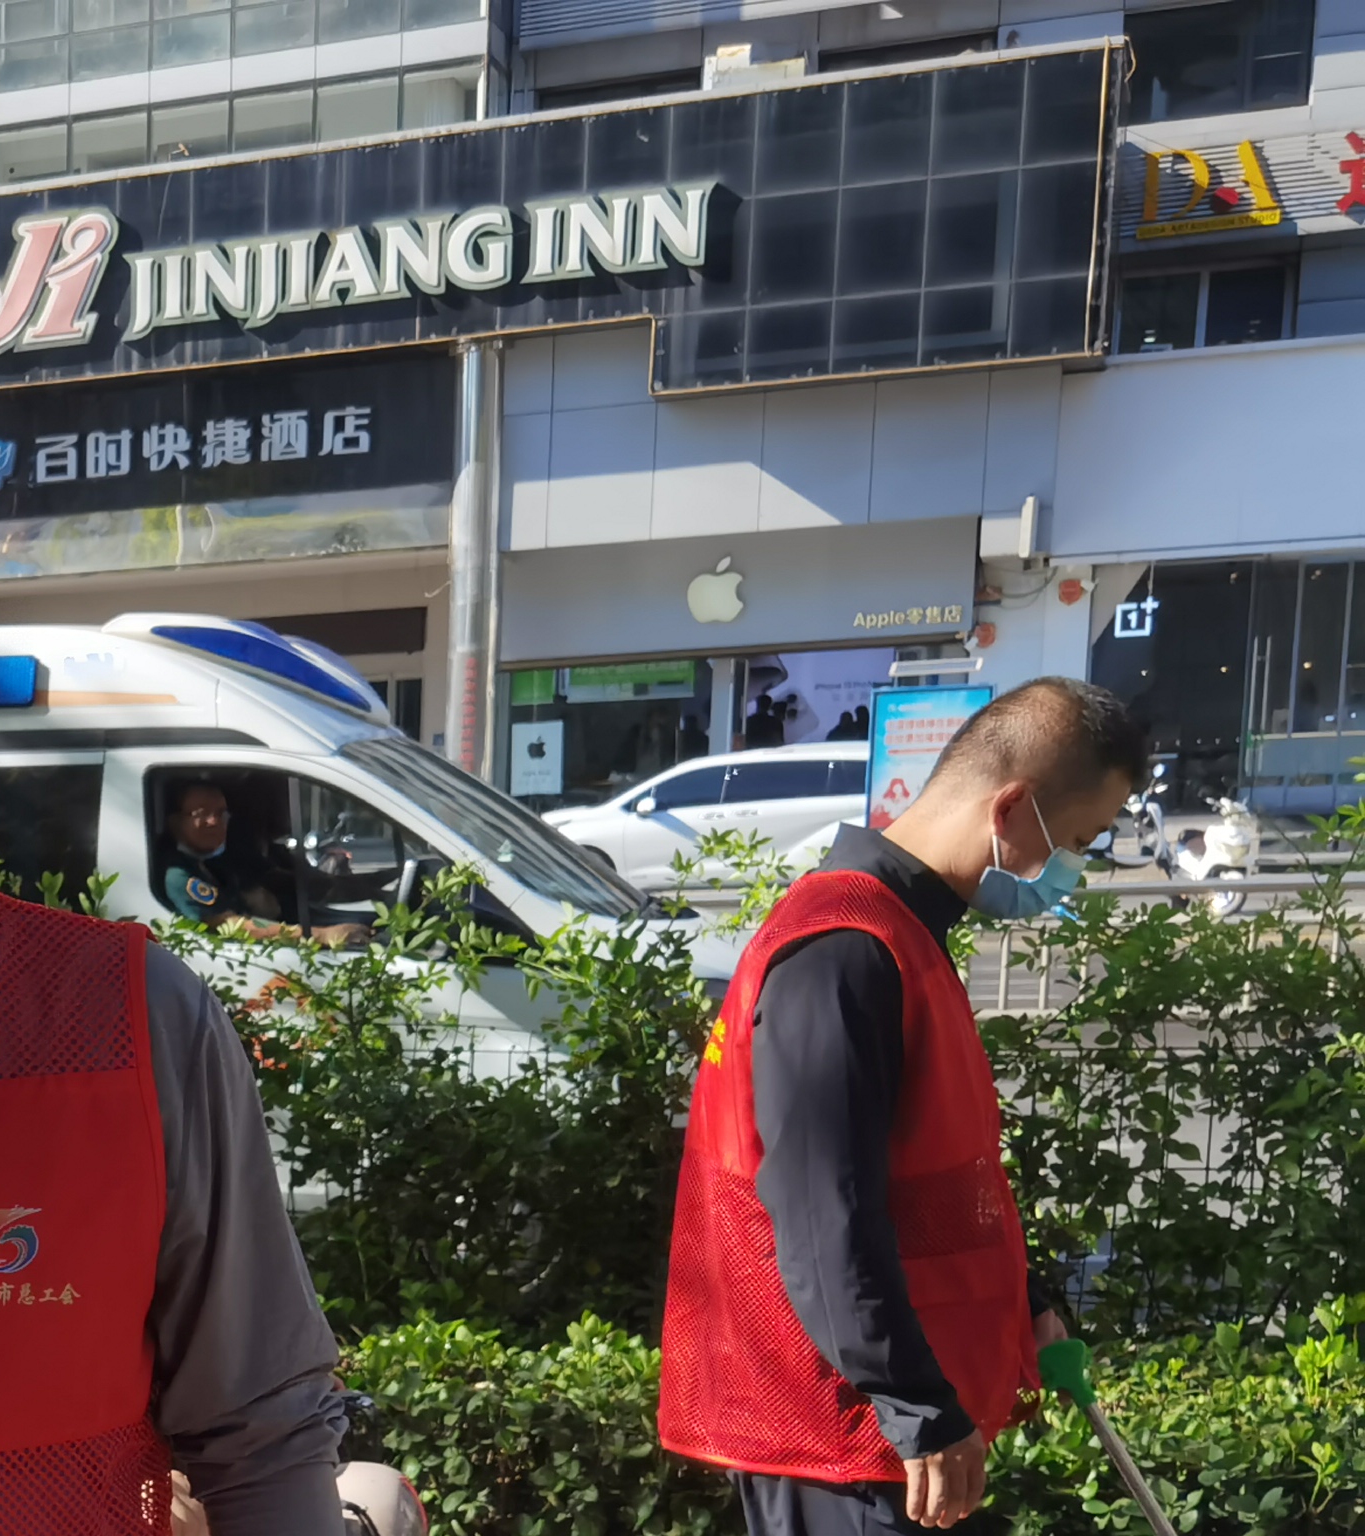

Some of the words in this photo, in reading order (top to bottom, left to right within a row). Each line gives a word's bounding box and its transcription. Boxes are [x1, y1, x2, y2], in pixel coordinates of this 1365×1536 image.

[125, 204, 515, 343] JINJIANG
[521, 182, 718, 284] INN
[33, 405, 373, 484] 百时快捷酒店
[853, 604, 963, 629] Apple零售店
